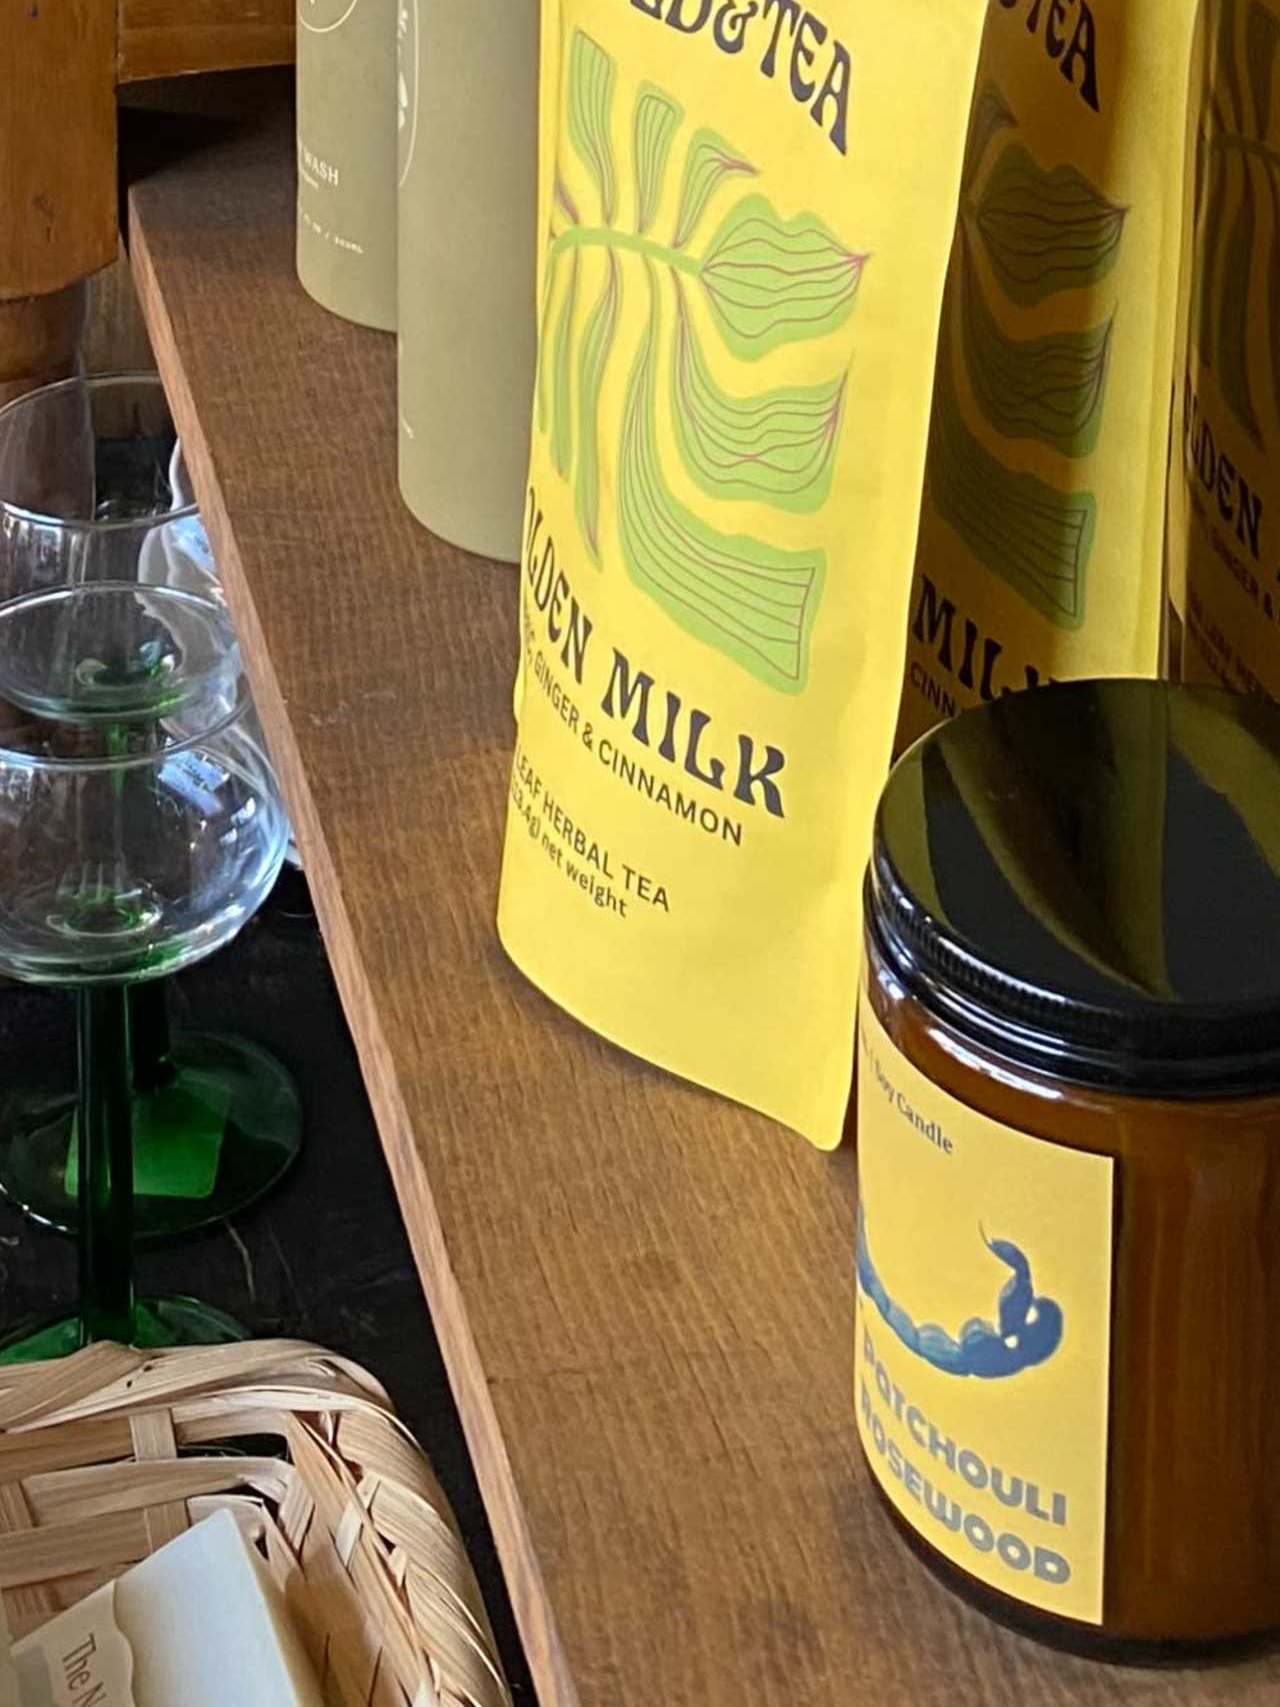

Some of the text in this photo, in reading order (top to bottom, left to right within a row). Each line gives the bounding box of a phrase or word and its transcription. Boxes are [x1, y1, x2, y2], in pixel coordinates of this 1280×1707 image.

[601, 646, 786, 820] MILK
[910, 660, 956, 718] CINN
[534, 650, 743, 847] GINGER & CINNAMON
[541, 832, 563, 868] net
[566, 860, 629, 919] weight
[542, 790, 614, 880] HERBAL
[621, 863, 670, 913] TEA
[896, 1091, 954, 1156] Candle
[860, 1373, 1071, 1585] ROSEWOOD
[61, 1632, 97, 1692] The
